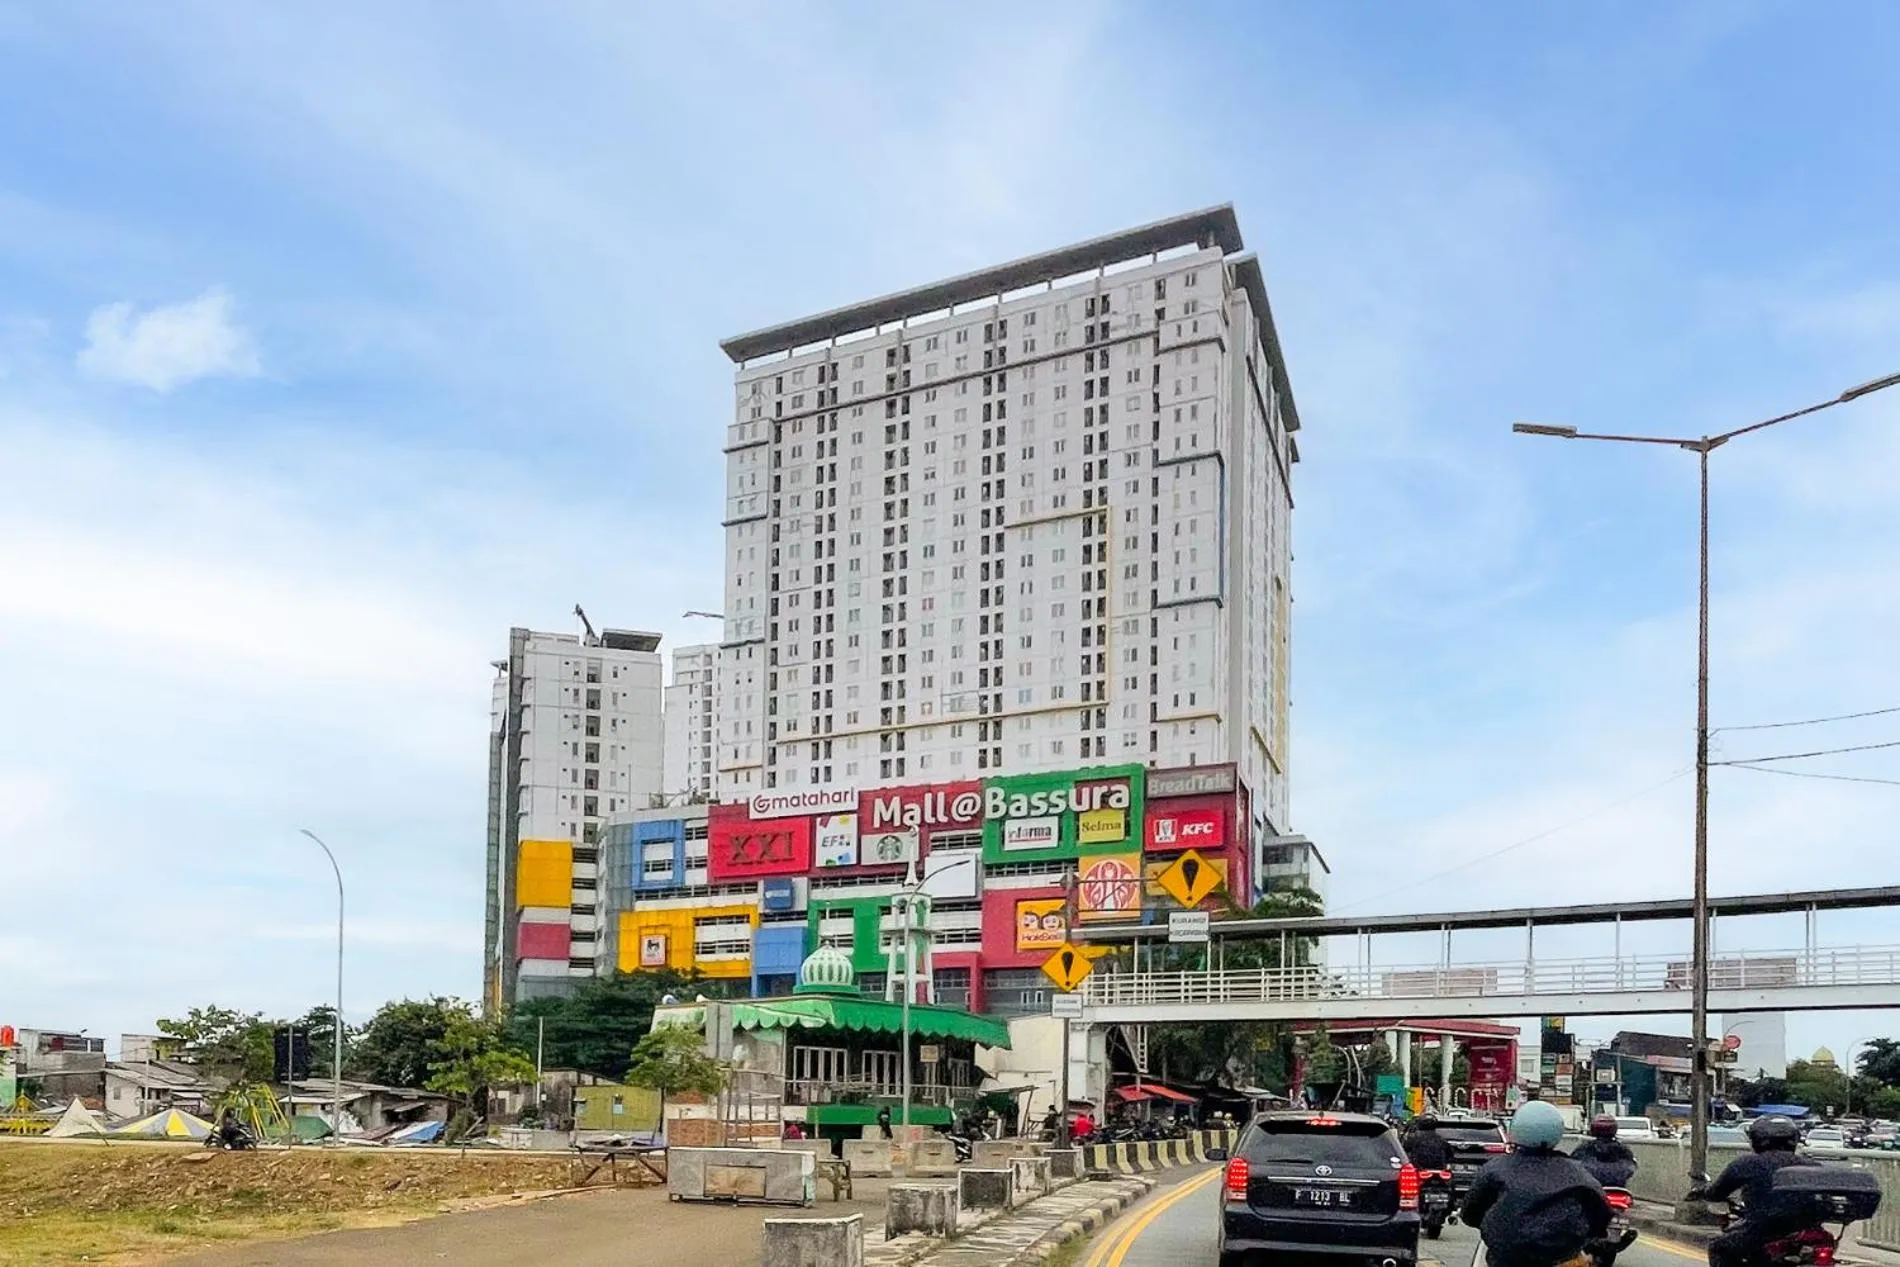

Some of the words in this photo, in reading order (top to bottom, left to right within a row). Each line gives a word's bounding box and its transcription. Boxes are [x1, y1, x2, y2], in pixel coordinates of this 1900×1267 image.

[1151, 772, 1231, 795] BreadTalk
[772, 788, 854, 809] matahari
[873, 783, 1130, 828] Mall@Bassura
[1082, 820, 1122, 833] Selma
[1181, 822, 1214, 836] KFC
[727, 831, 795, 866] XXI
